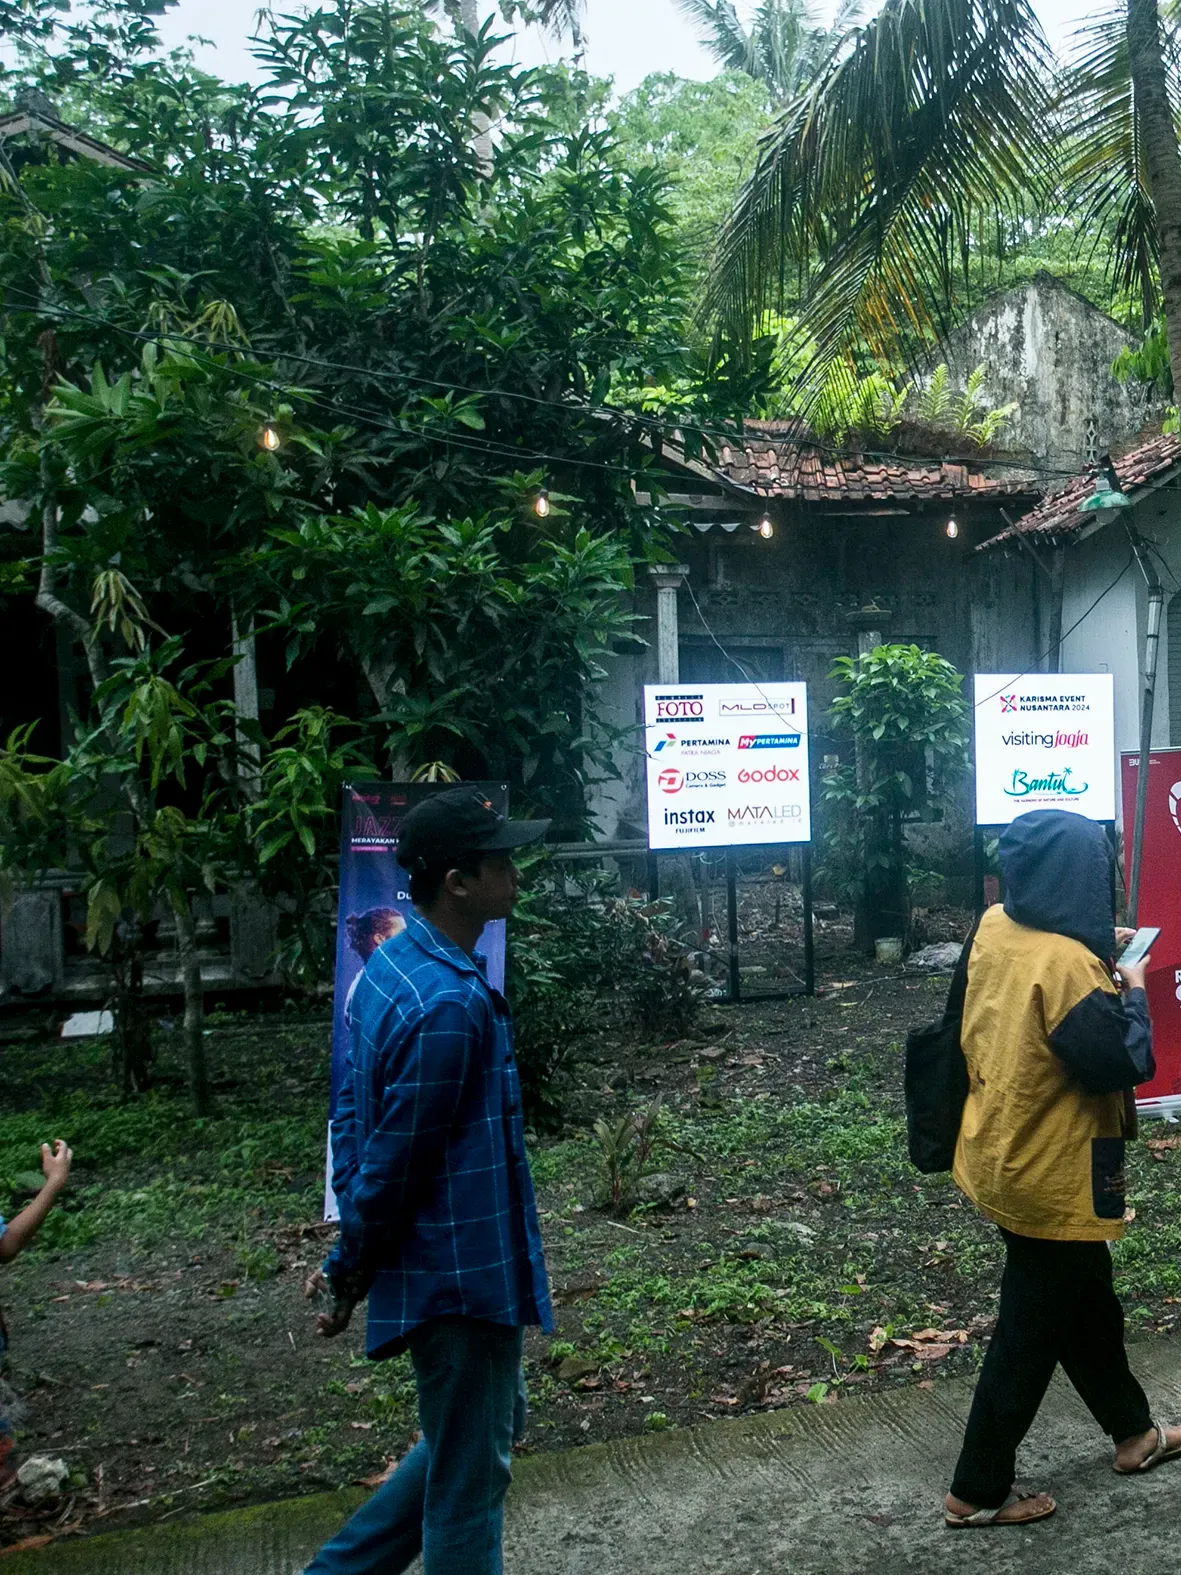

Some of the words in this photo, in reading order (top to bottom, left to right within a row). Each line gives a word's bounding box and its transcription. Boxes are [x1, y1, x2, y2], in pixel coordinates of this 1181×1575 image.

[657, 701, 703, 717] FOTO
[1020, 704, 1070, 712] NUSANTARA
[681, 738, 731, 747] PERTAMINA
[686, 771, 727, 782] DOSS
[737, 765, 800, 783] Godox
[1003, 766, 1089, 796] Bantul
[664, 807, 715, 825] instax
[675, 826, 705, 834] FUJIFILM
